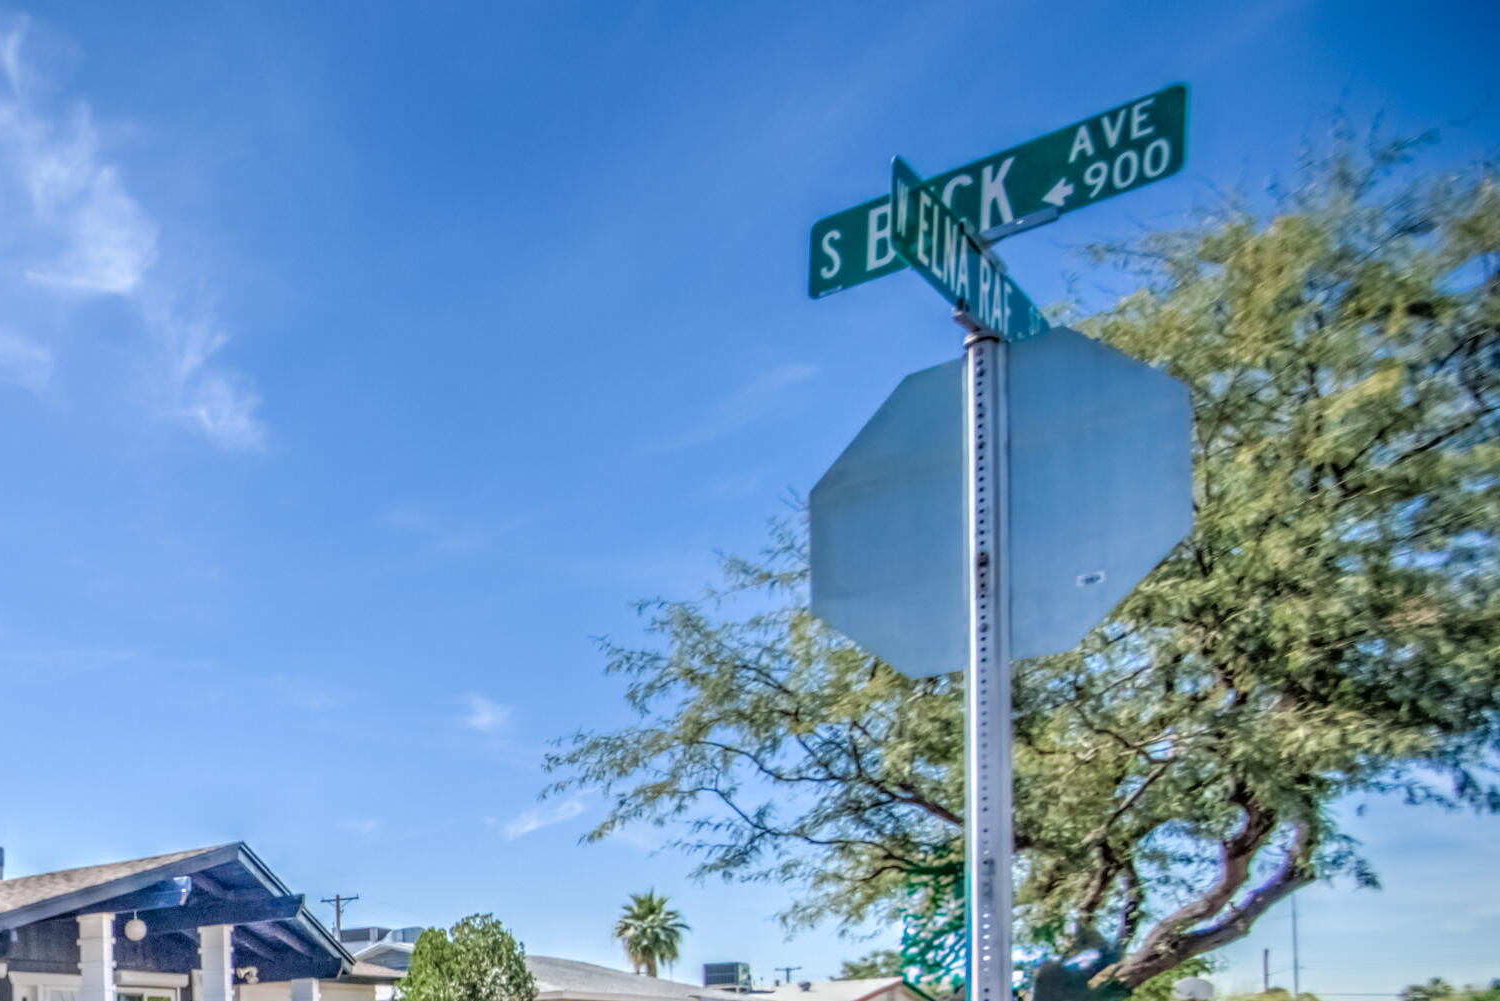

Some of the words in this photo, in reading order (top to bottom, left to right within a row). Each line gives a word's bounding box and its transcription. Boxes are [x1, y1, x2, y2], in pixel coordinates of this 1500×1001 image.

[820, 229, 842, 279] S
[866, 156, 1016, 272] BCK
[1068, 97, 1156, 164] AVE
[1083, 137, 1171, 199] 900
[916, 189, 969, 300] ELNA
